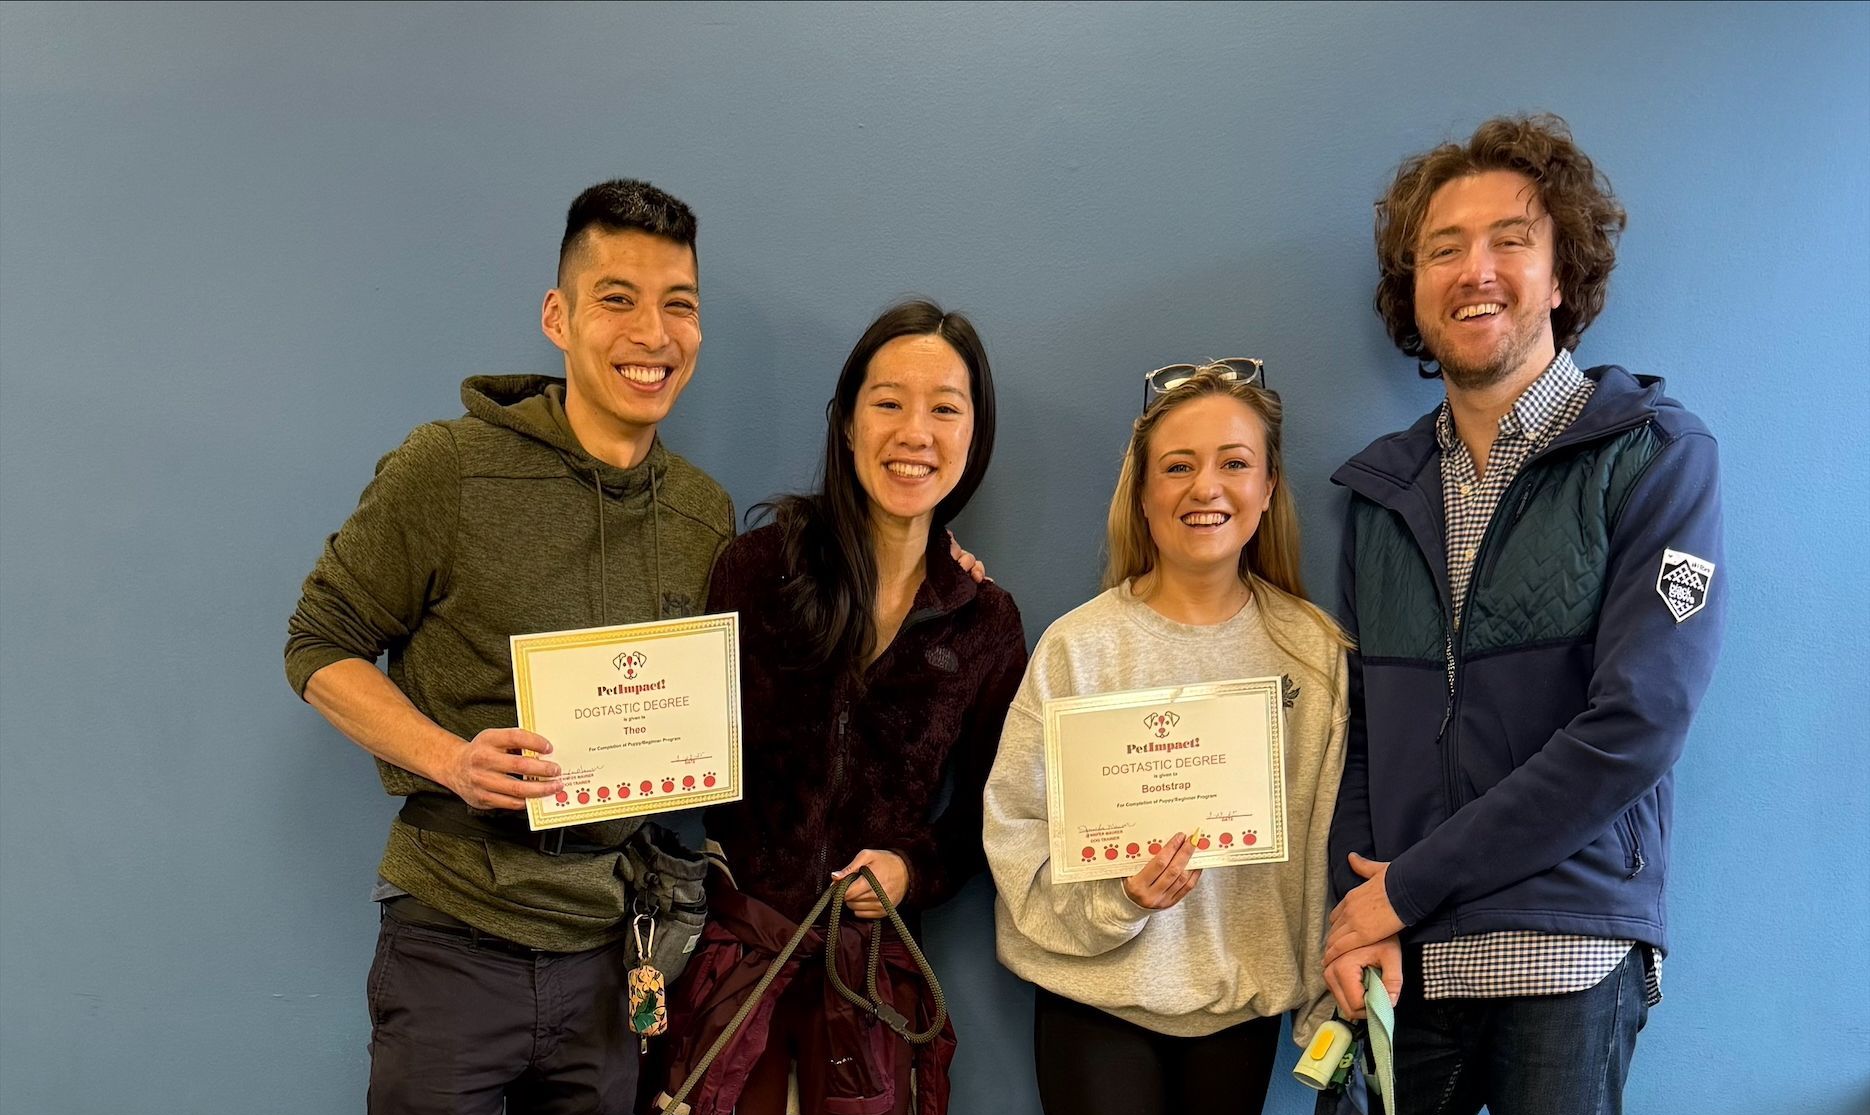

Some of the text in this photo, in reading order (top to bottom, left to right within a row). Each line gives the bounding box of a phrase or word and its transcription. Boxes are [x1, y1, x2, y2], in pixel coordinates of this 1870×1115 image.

[597, 679, 666, 697] PetImpact!
[574, 696, 690, 720] DOGTASTIC DEGREE
[624, 726, 646, 735] Theo
[1126, 737, 1200, 754] PetImpact!
[1102, 754, 1226, 777] DOGTASTIC DEGREE
[1142, 781, 1191, 793] Bootstrap
